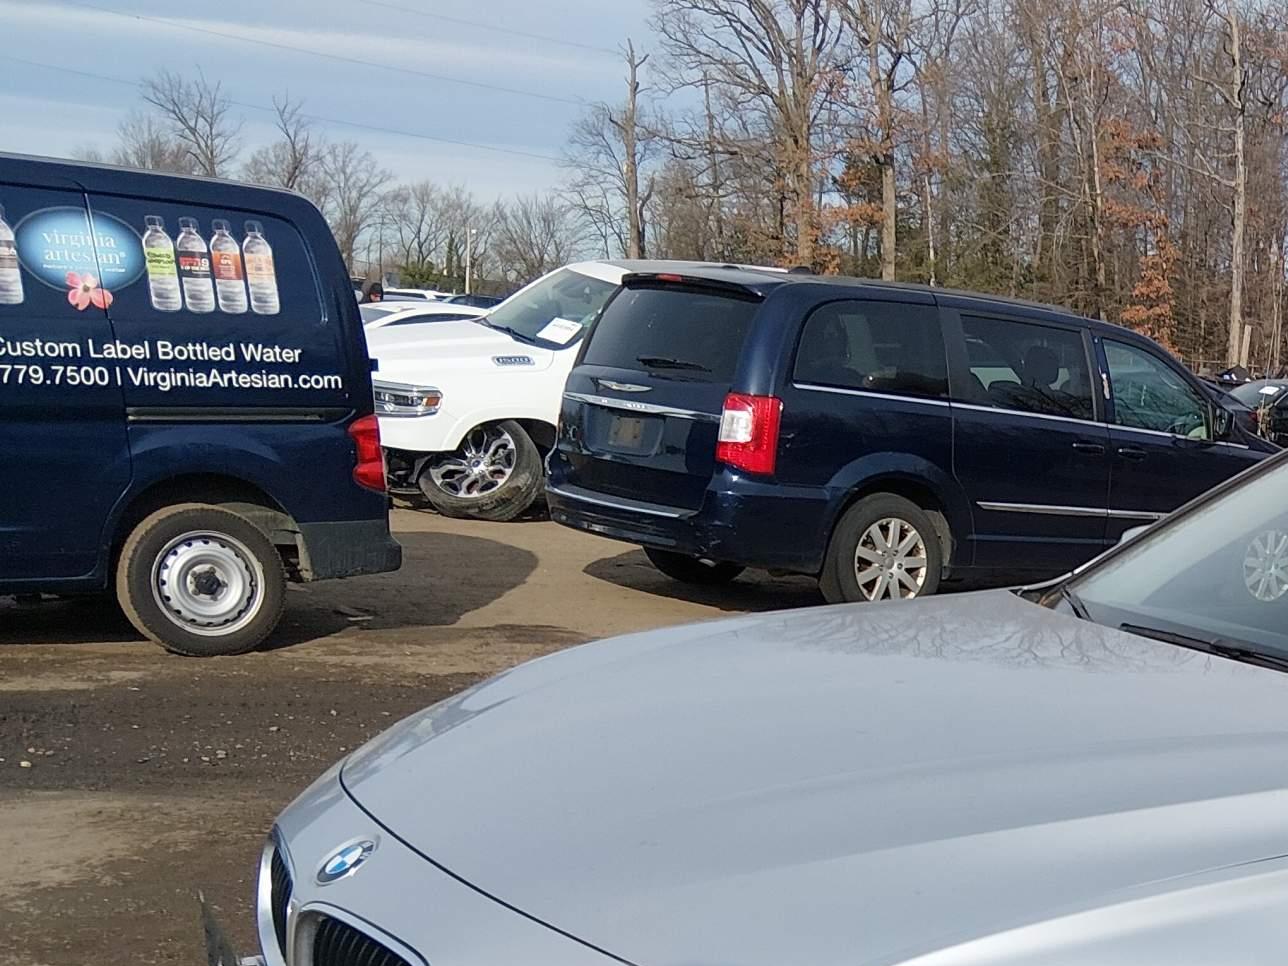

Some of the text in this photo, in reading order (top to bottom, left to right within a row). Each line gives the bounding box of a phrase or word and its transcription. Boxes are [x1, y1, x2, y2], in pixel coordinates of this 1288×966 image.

[88, 339, 151, 360] Label
[156, 341, 236, 362] Bottled
[241, 343, 302, 363] Water
[127, 367, 343, 391] VirginiaArtesian.com
